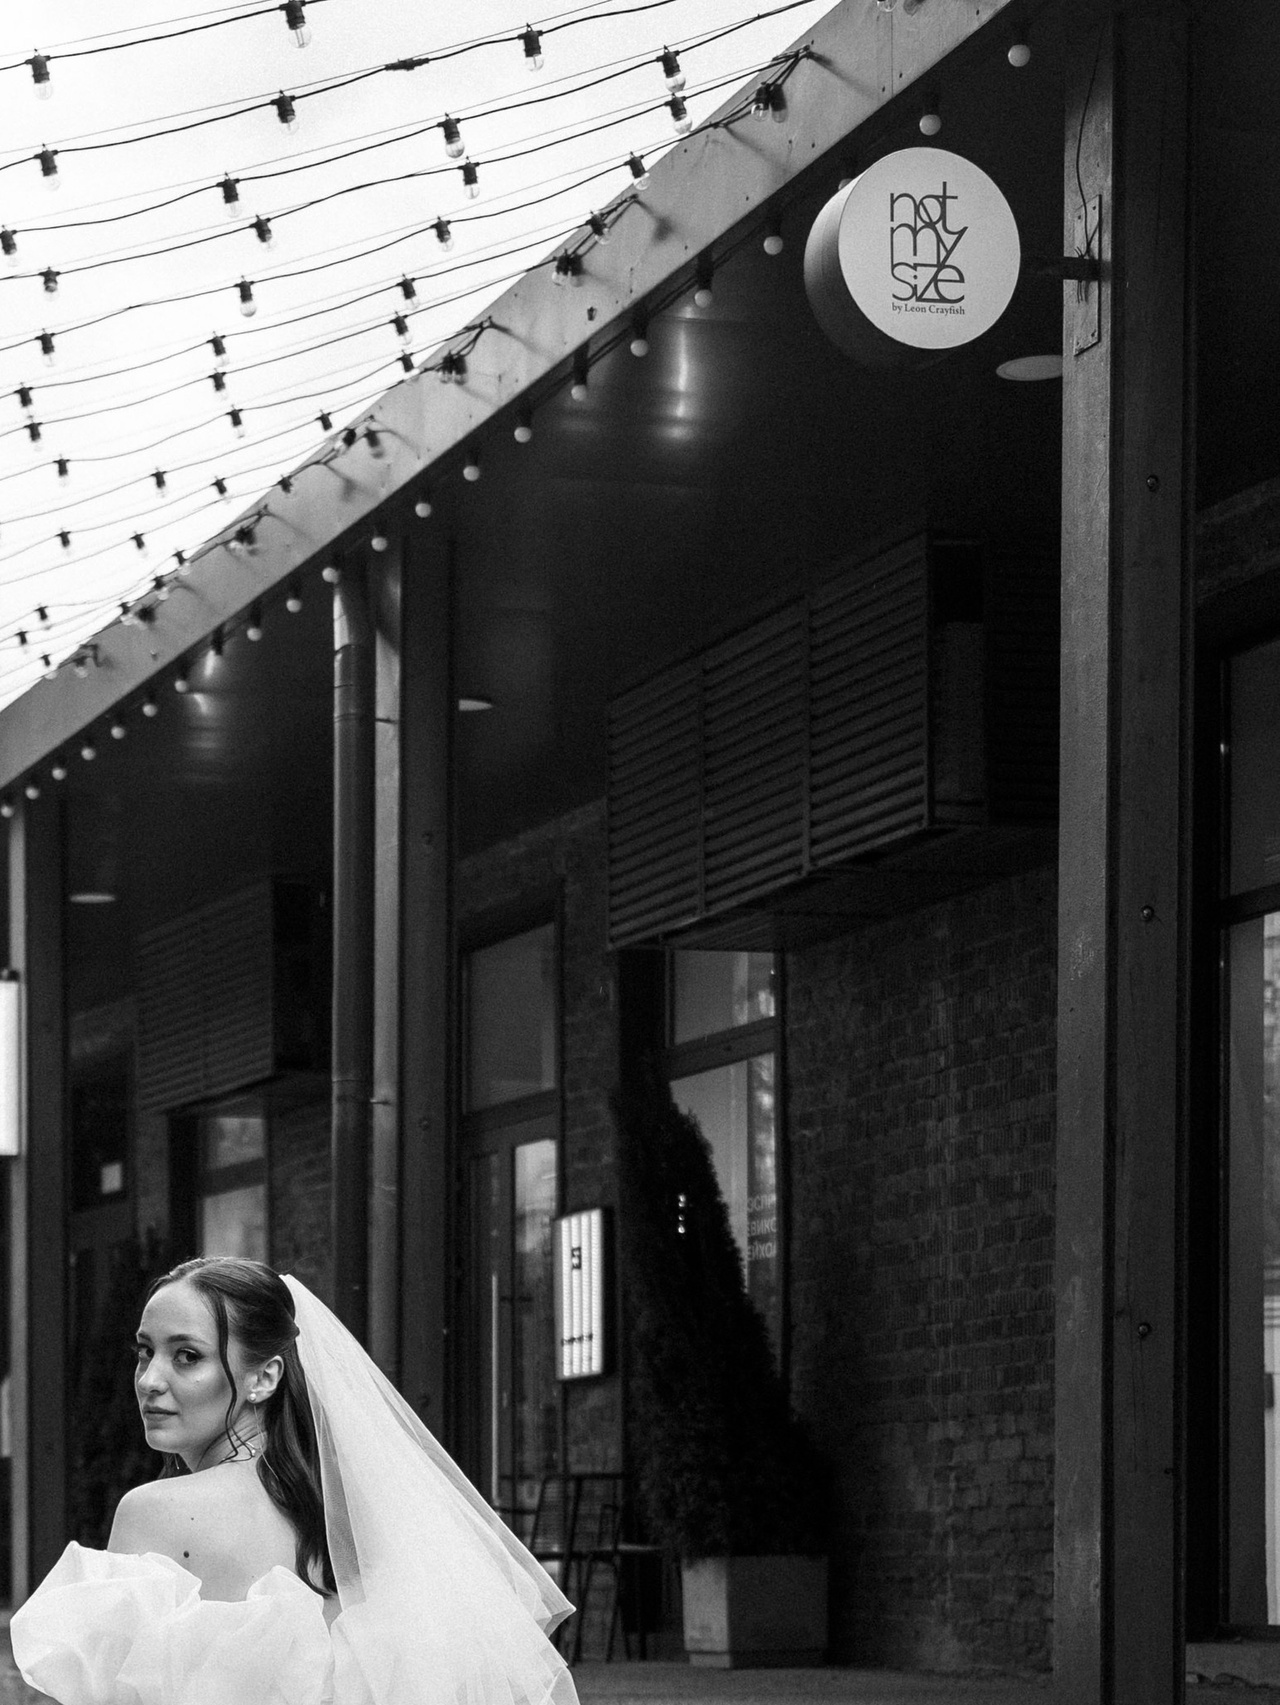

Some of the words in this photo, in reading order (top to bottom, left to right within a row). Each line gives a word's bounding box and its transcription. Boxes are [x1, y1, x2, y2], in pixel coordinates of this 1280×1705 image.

[890, 181, 960, 234] not
[890, 222, 969, 267] my
[891, 262, 966, 303] size
[891, 302, 903, 315] by
[904, 303, 927, 314] Leon
[928, 304, 965, 317] Crayfish
